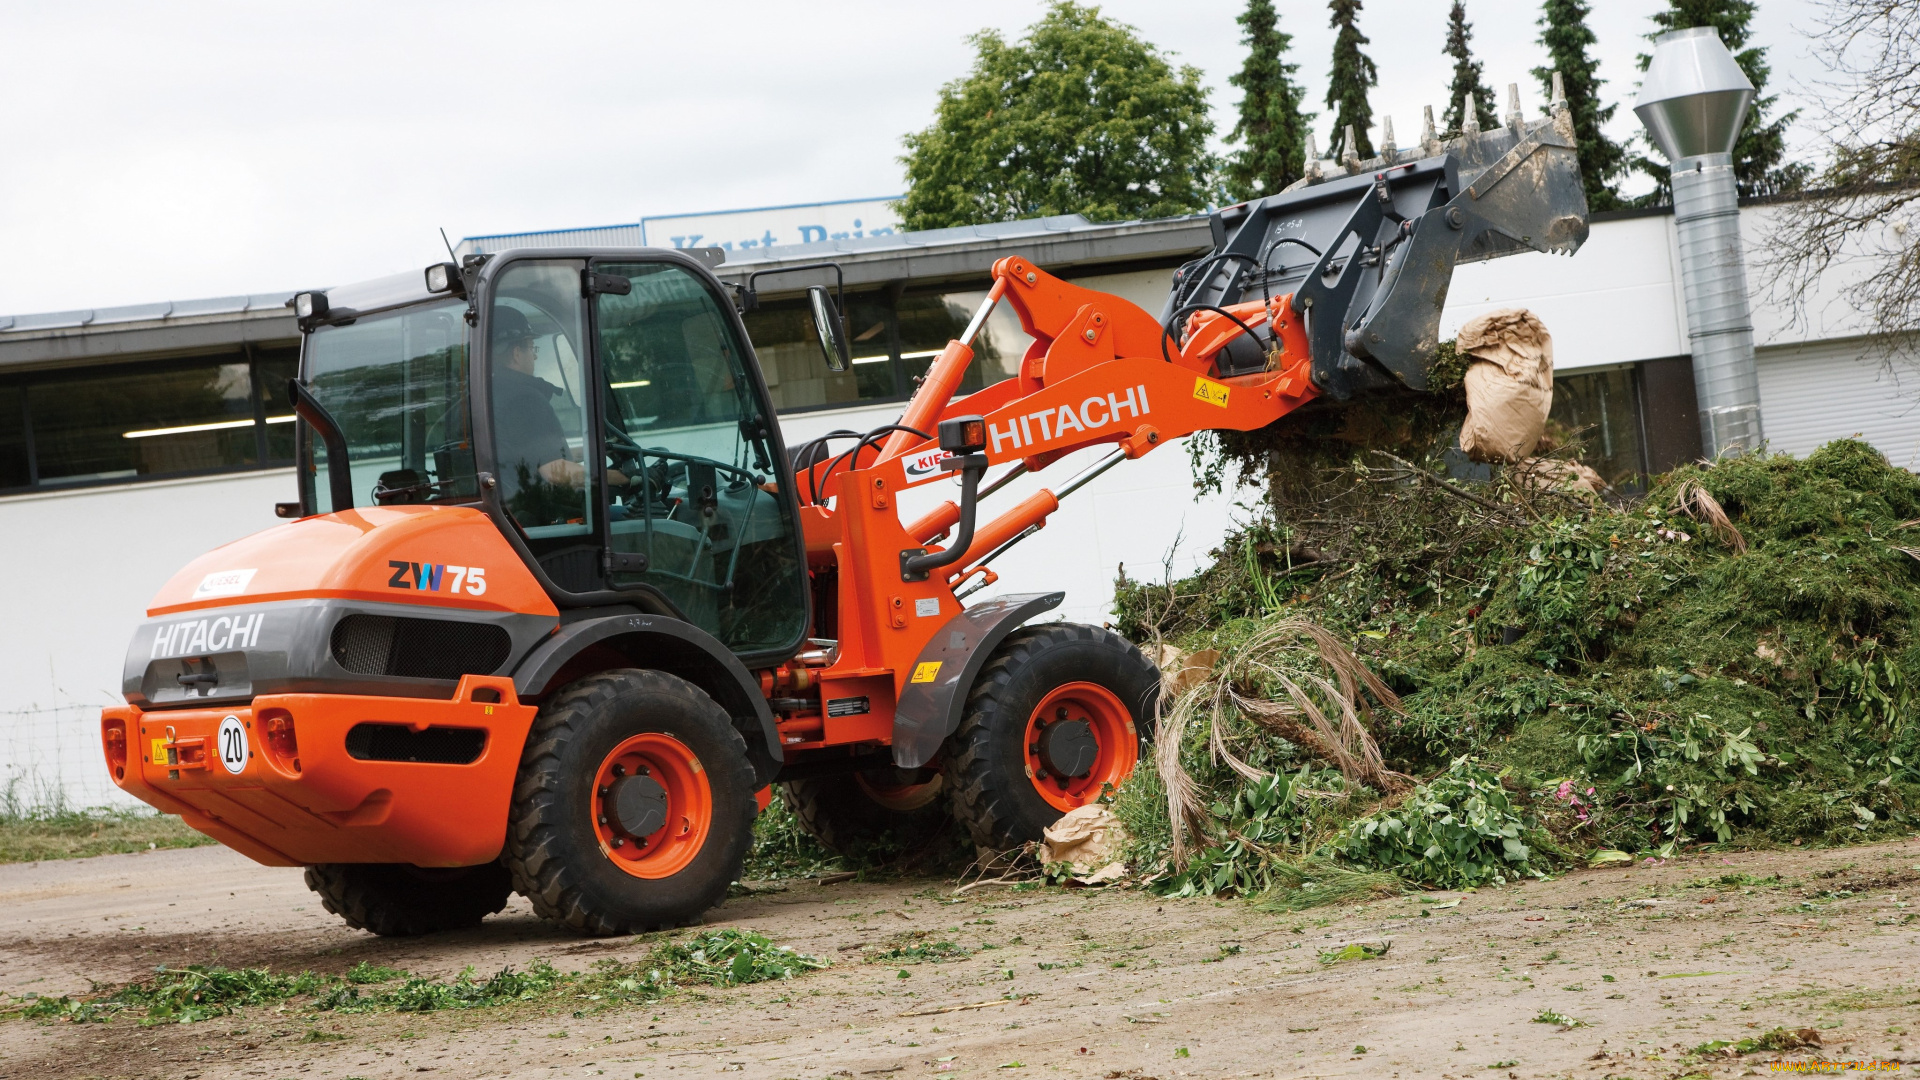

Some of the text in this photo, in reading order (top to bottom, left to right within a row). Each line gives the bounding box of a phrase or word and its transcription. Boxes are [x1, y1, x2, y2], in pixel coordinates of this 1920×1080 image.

[988, 384, 1151, 454] HITACHI
[917, 450, 954, 469] KIES
[150, 613, 265, 659] HITACHI
[224, 727, 243, 763] 20
